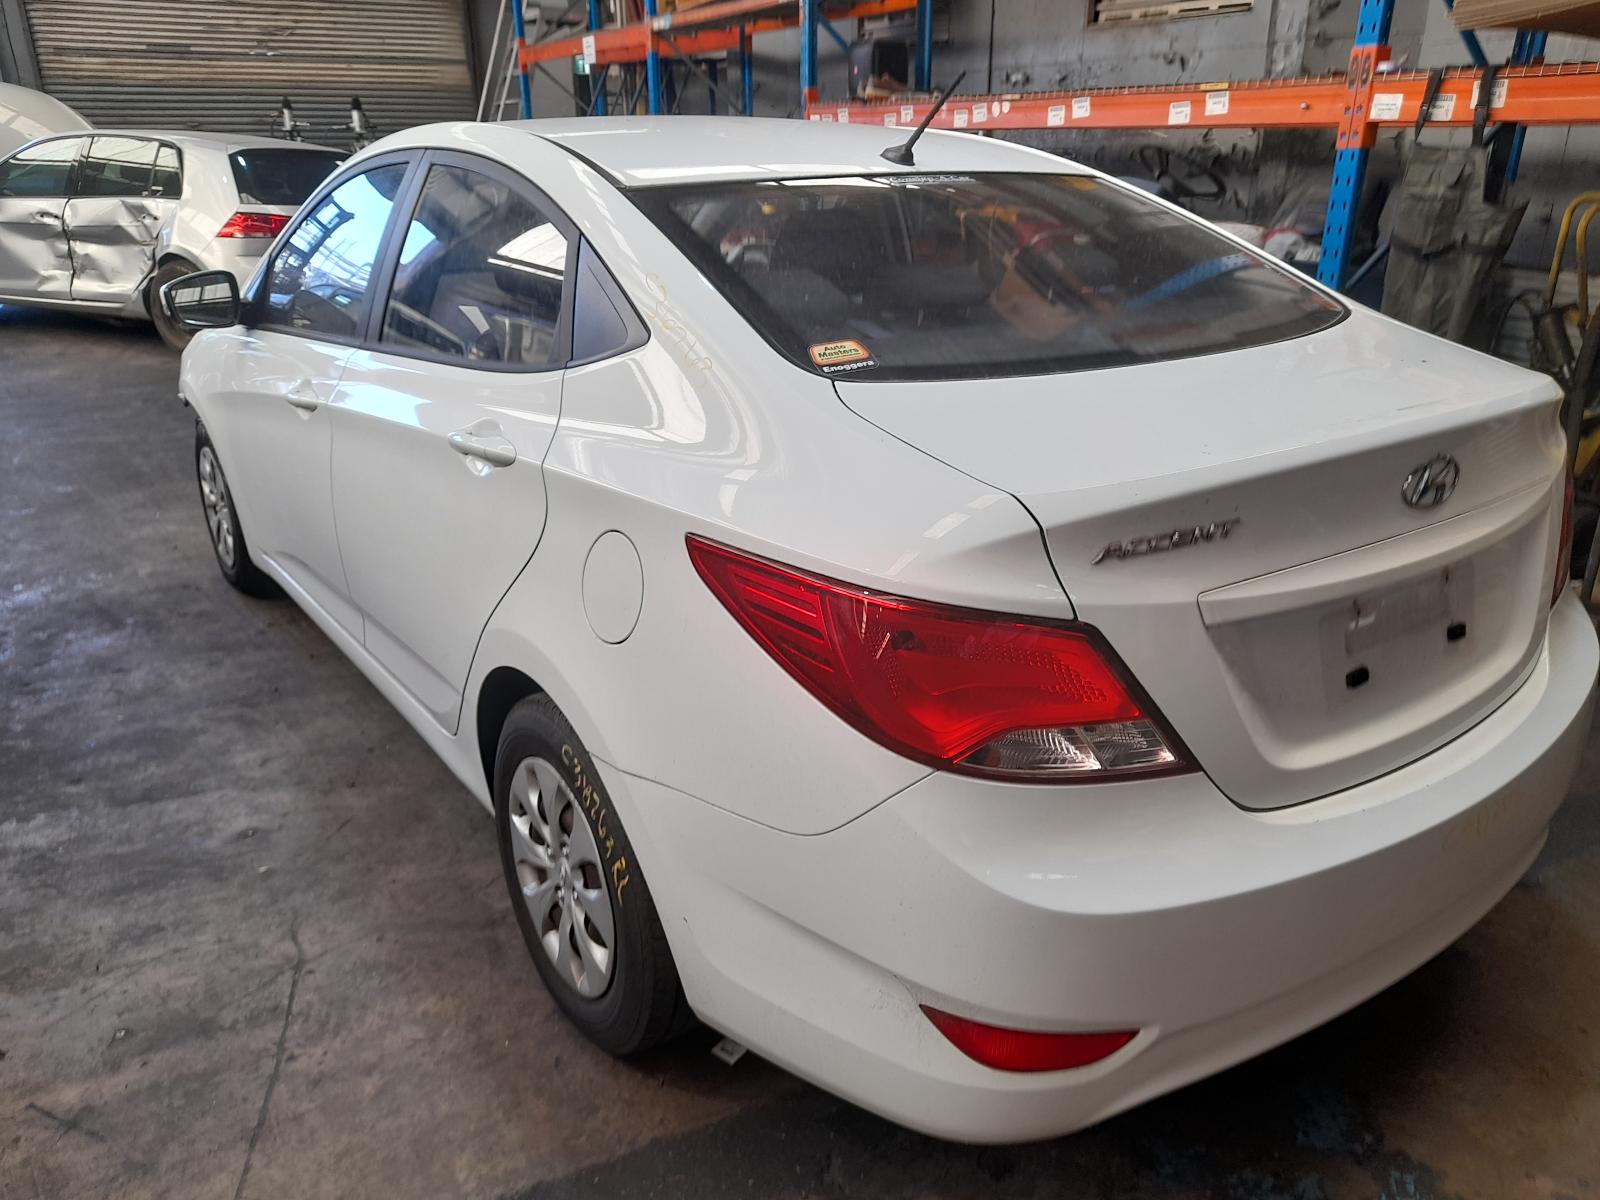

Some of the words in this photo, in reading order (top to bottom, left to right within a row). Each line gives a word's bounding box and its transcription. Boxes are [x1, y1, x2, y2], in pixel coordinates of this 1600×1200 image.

[818, 347, 859, 358] Masters
[824, 344, 846, 352] Auto
[822, 360, 875, 373] Enoggera
